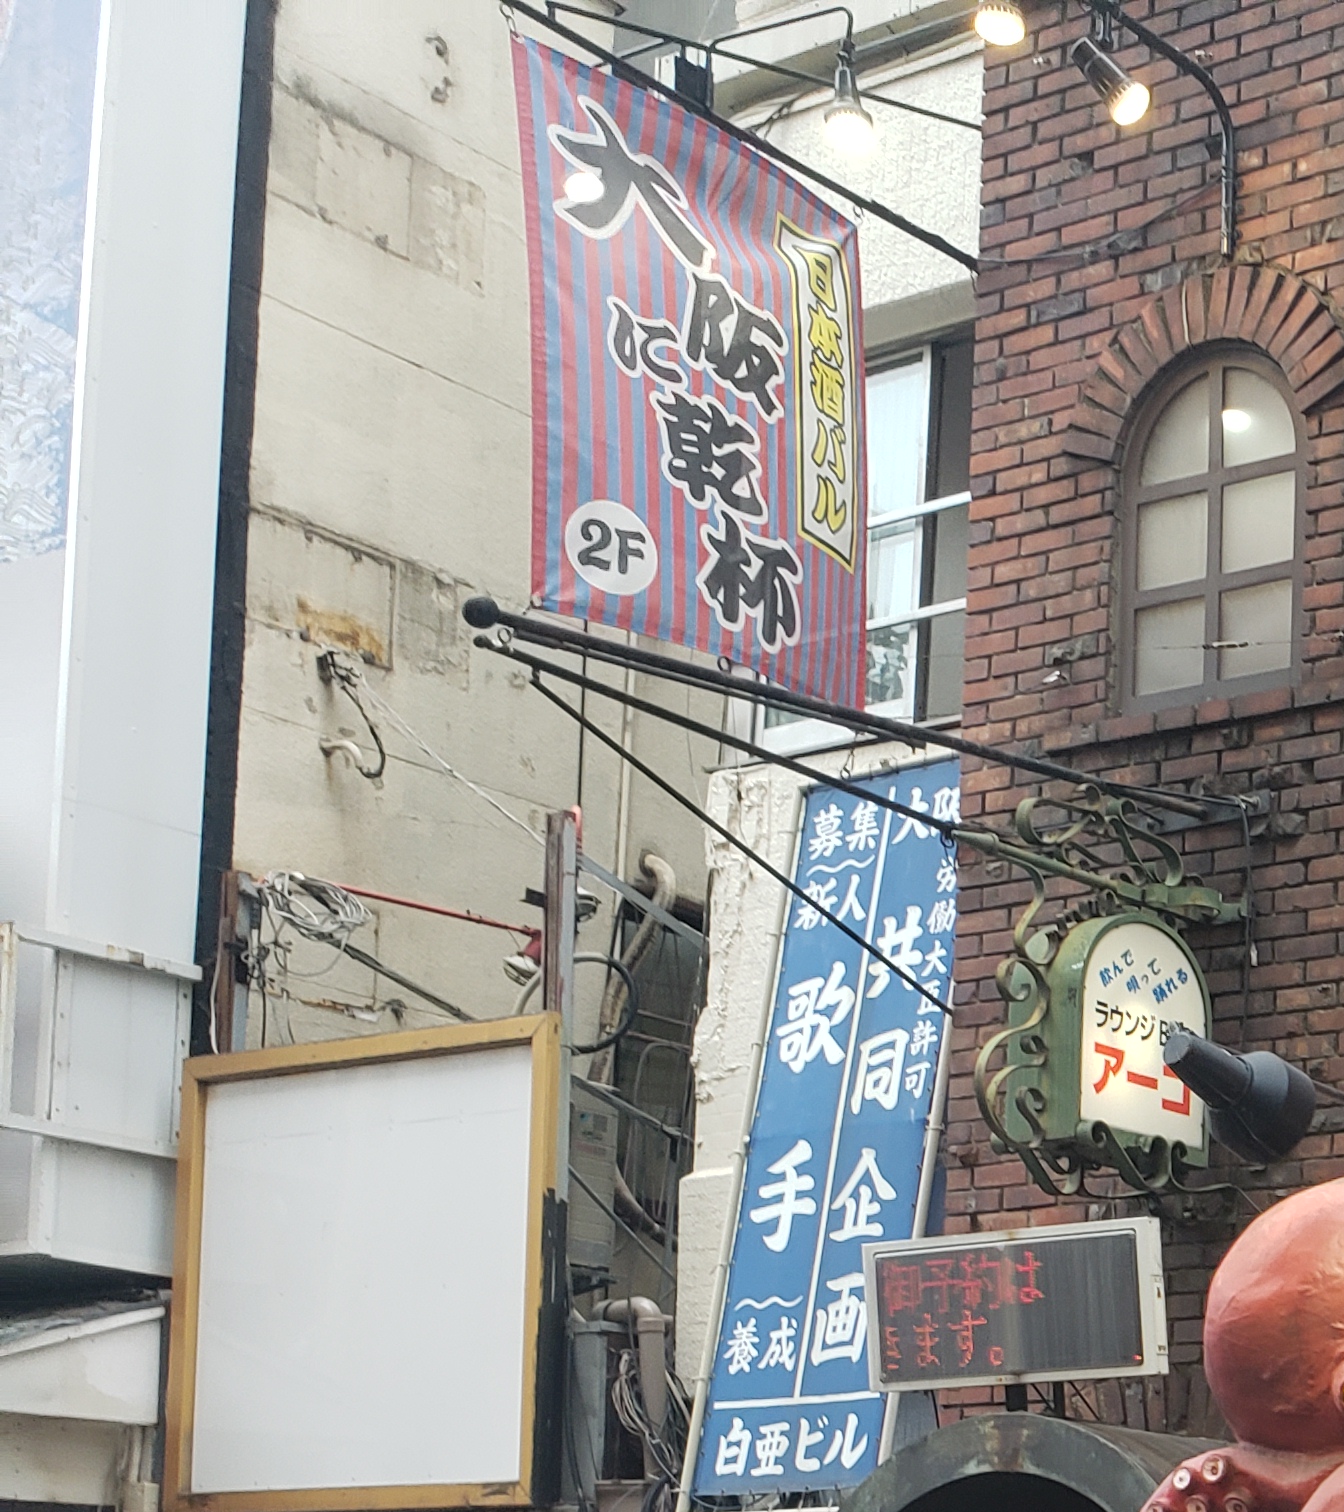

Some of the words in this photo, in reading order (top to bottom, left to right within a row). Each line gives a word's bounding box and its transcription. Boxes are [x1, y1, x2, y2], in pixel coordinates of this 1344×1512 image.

[548, 95, 802, 653] 大阪に乾杯
[800, 242, 845, 530] 日本酒バル
[577, 519, 646, 574] 2F
[808, 800, 879, 859] 募集
[793, 873, 866, 929] 新人
[1099, 949, 1134, 988] 飲んで
[1095, 1001, 1156, 1041] ラウンジ
[749, 960, 855, 1253] 歌手
[810, 906, 922, 1368] 共同企画
[723, 1317, 797, 1373] 養成
[713, 1413, 868, 1478] 白亜ビル
